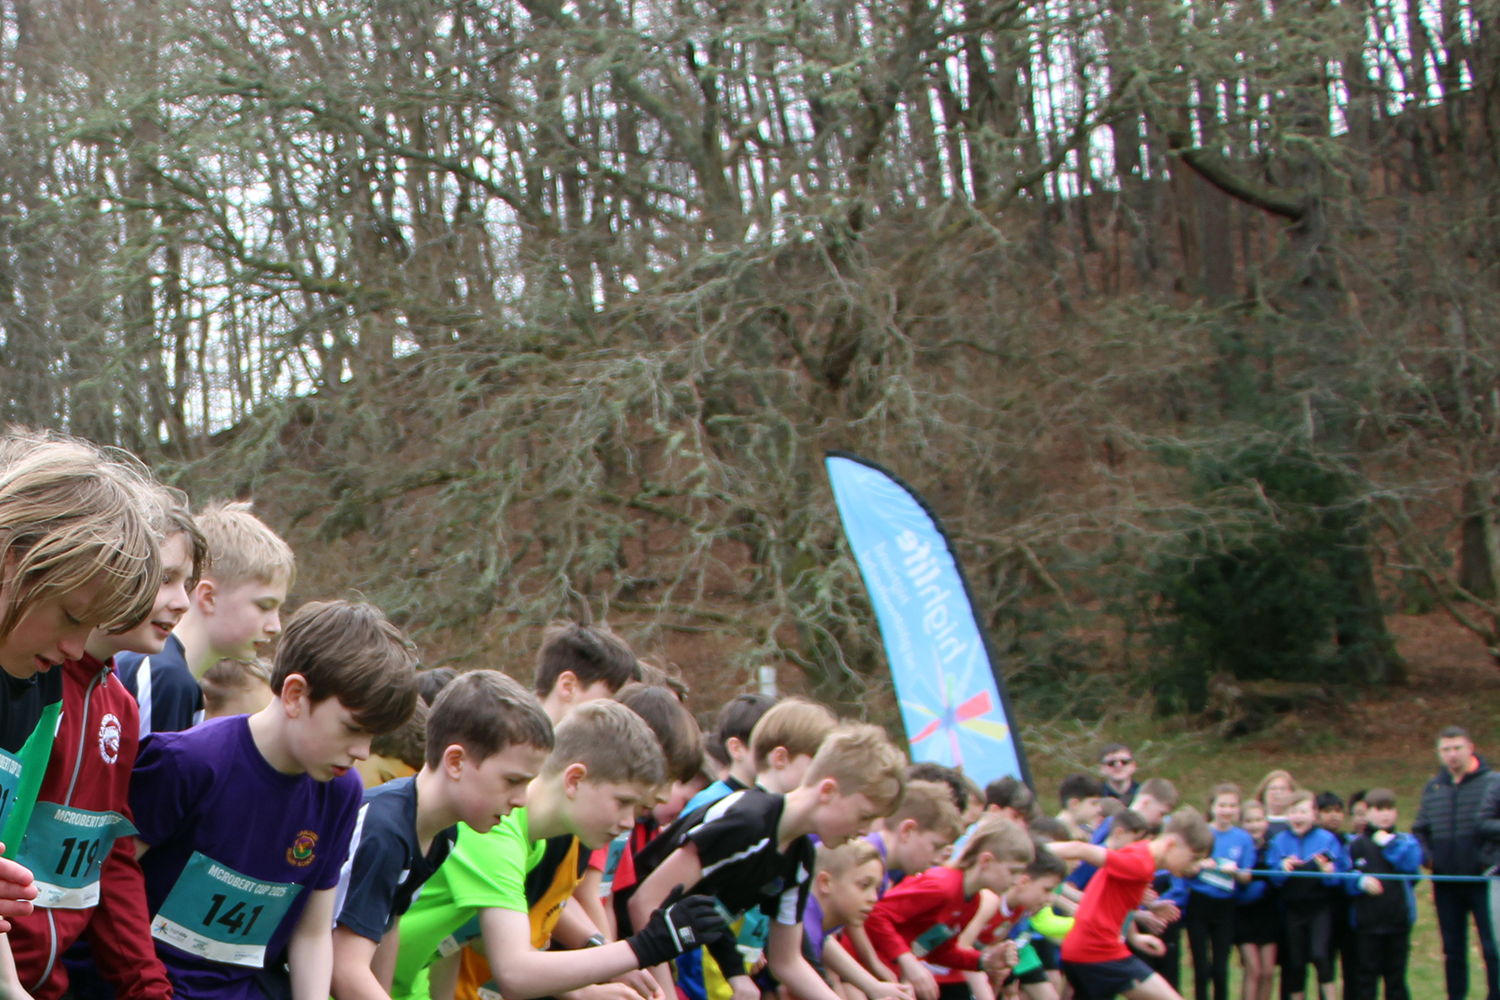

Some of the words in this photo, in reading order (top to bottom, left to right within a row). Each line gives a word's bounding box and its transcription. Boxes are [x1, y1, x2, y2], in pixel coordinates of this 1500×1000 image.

[54, 809, 99, 827] MCROBERT
[208, 864, 256, 893] MCROBERT
[253, 883, 271, 896] CUP
[268, 885, 288, 897] 2025
[202, 893, 265, 936] 141
